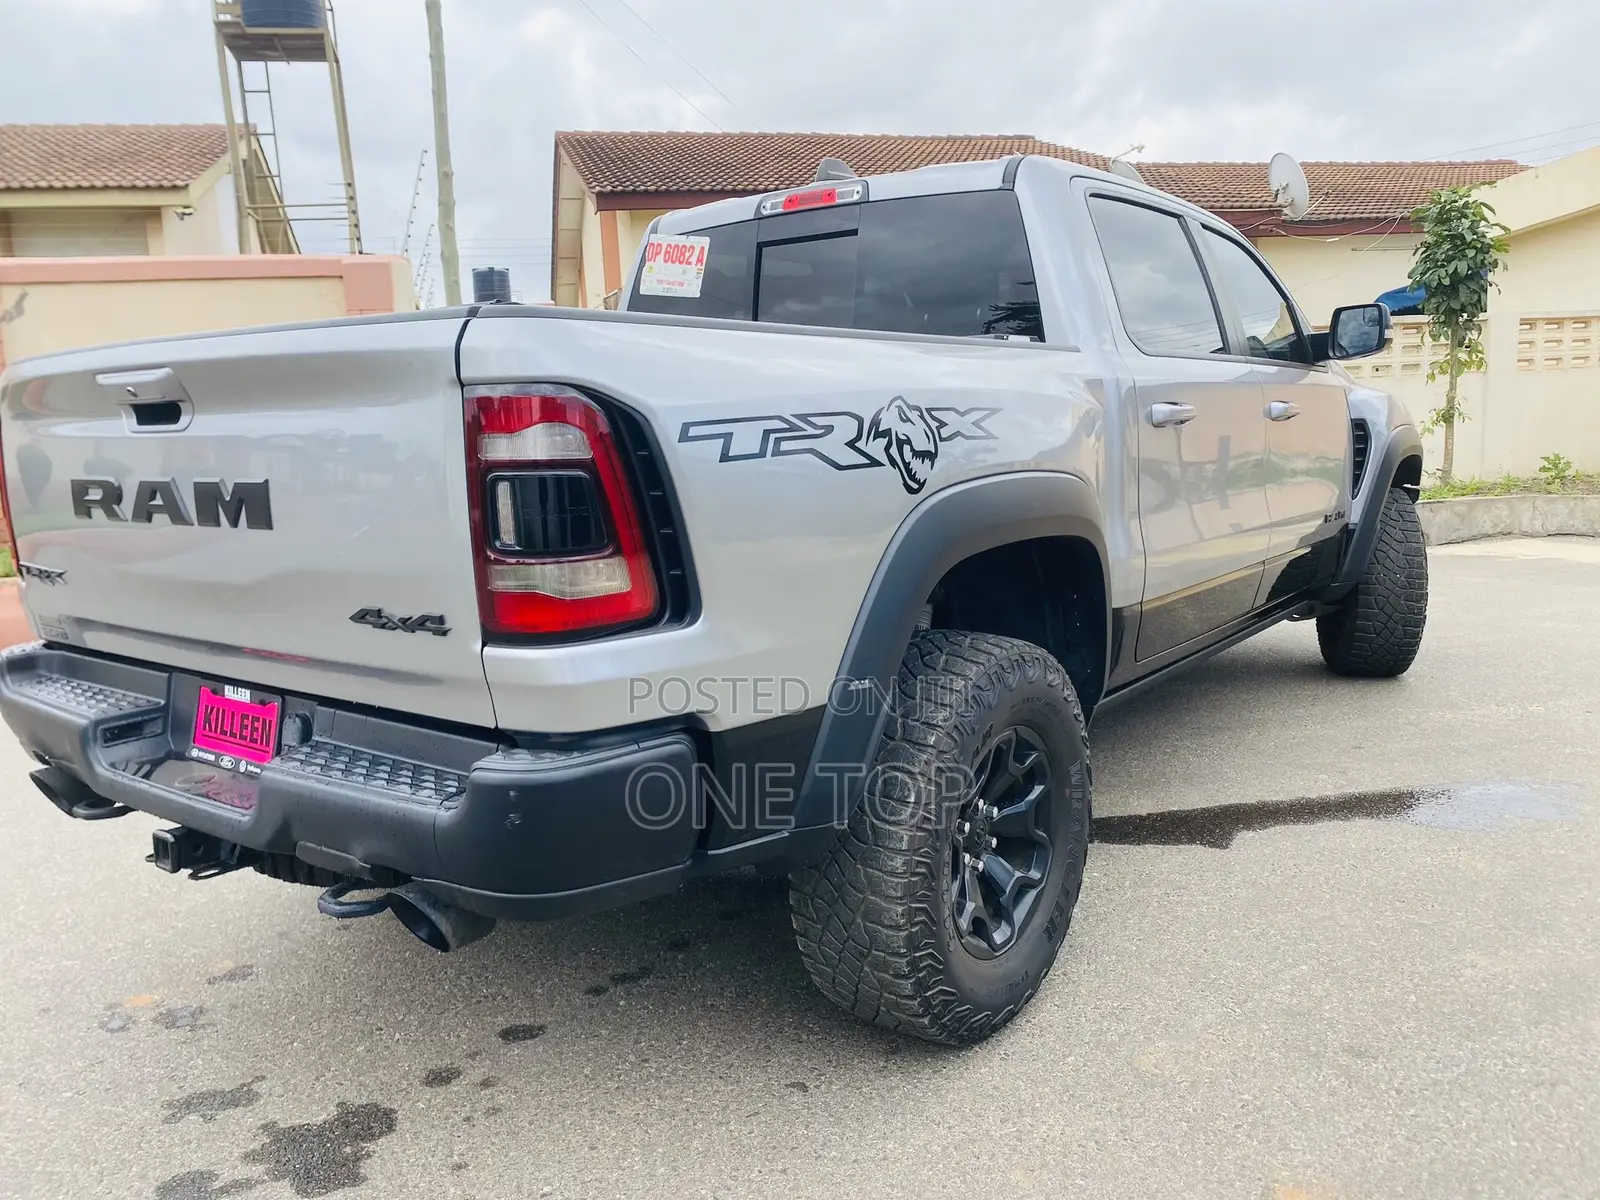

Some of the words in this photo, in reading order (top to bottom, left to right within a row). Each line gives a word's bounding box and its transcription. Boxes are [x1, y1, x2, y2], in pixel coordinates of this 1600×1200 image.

[647, 242, 663, 263] DP
[663, 243, 695, 266] 6082
[695, 245, 705, 266] A
[70, 476, 274, 530] RAM
[224, 684, 251, 701] KILLEEN
[202, 703, 273, 747] KILLEEN
